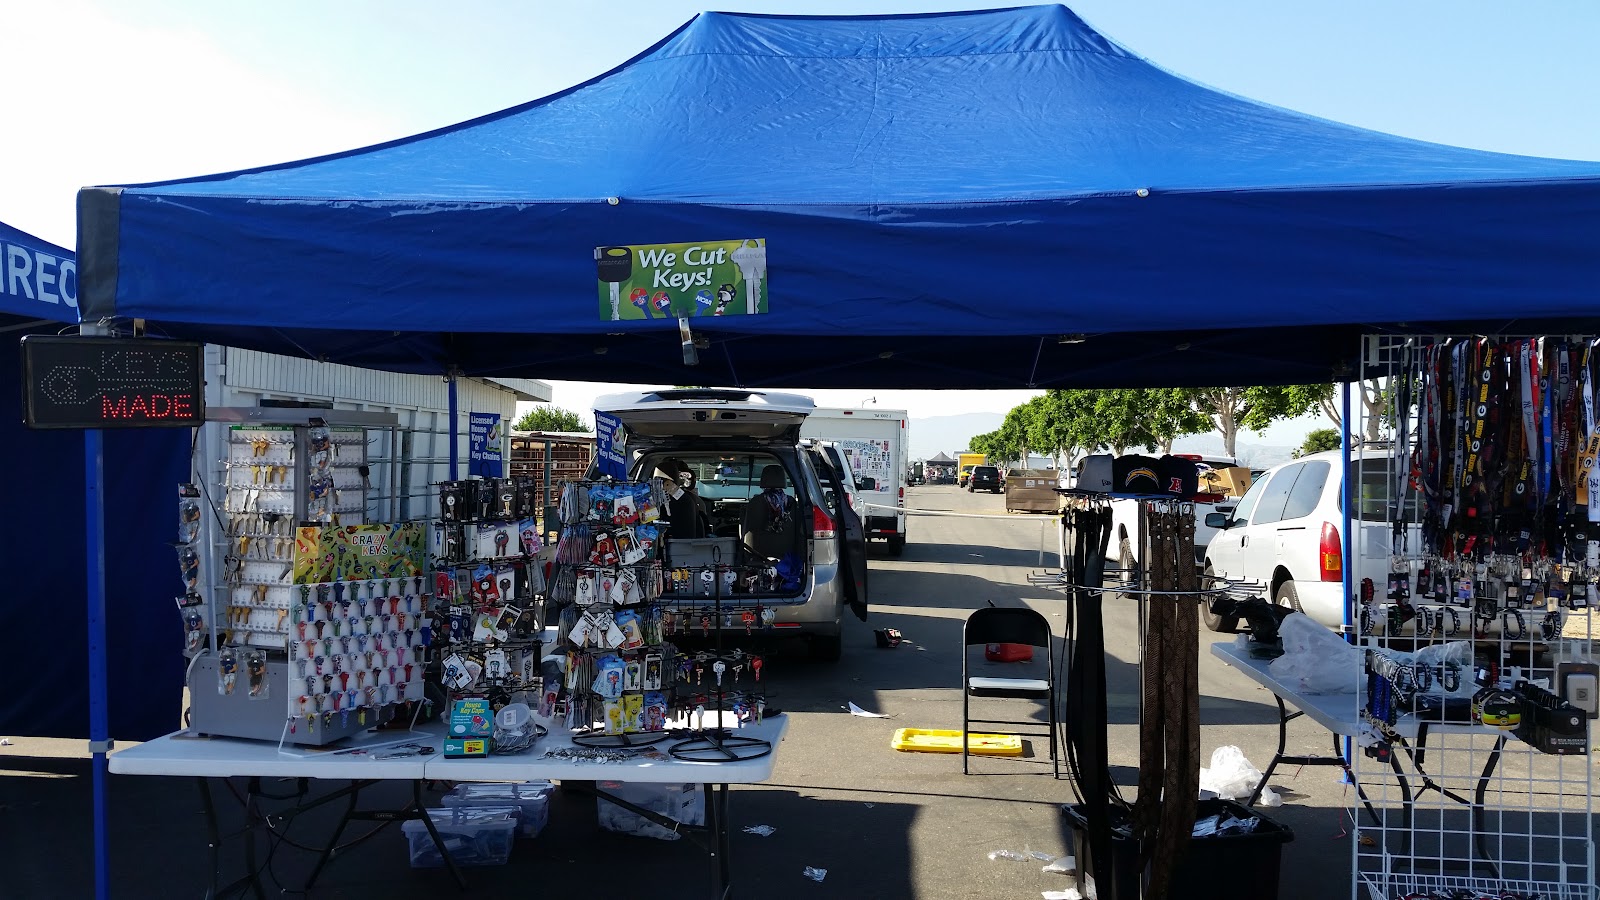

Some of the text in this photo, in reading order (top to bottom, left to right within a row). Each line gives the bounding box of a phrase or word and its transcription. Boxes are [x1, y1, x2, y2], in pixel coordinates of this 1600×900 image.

[638, 246, 726, 268] We Cut
[653, 268, 713, 292] Keys!
[101, 351, 190, 373] KEYS
[102, 394, 192, 418] MADE
[471, 416, 493, 424] Licensed
[471, 425, 487, 433] House
[472, 434, 484, 443] Keys
[472, 451, 500, 461] Key Chains
[352, 533, 387, 546] CRAZY
[362, 545, 389, 556] KEYS
